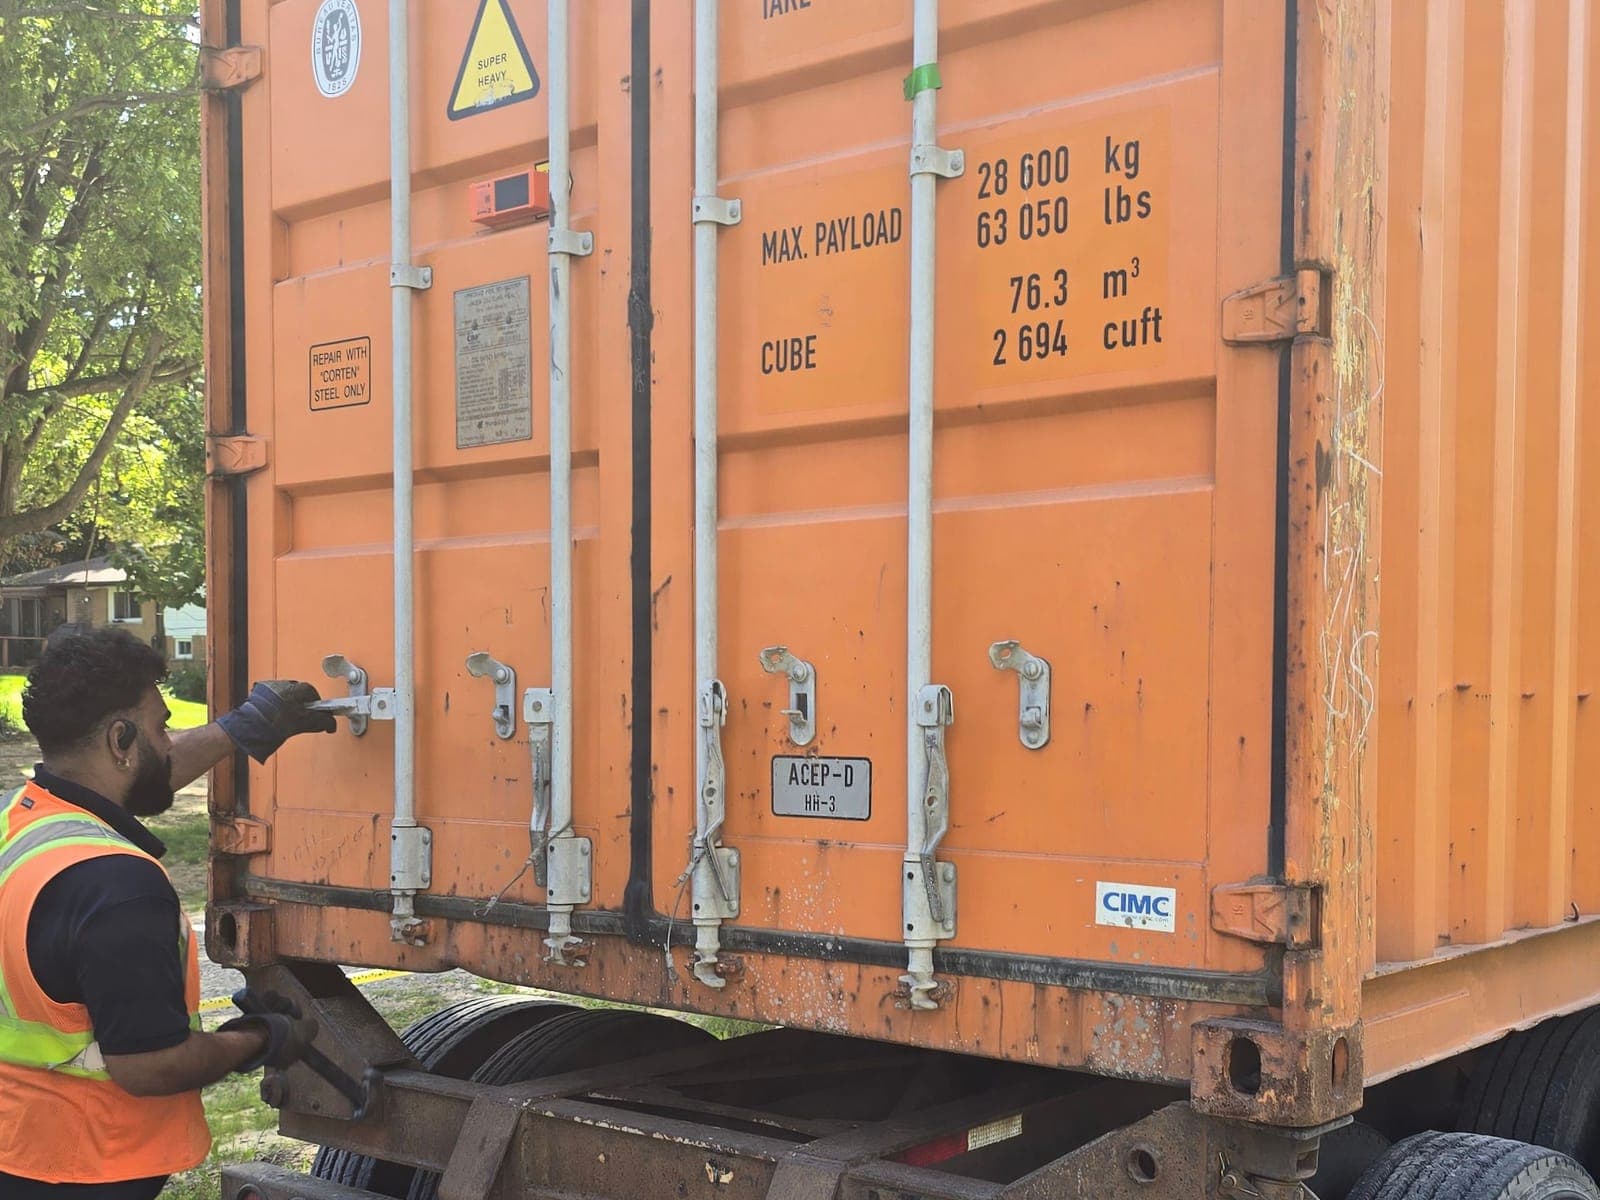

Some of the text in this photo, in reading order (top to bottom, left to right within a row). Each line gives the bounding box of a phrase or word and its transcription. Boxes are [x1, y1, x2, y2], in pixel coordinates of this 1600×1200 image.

[478, 53, 507, 70] SUPER
[478, 71, 507, 87] HEAVY
[978, 136, 1139, 199] 28 600 kg
[977, 185, 1151, 248] 63 050 lbs
[762, 208, 902, 266] MAX. PAYLOAD
[1010, 269, 1068, 313] 76.3
[993, 306, 1162, 365] 2 694 cuft
[313, 346, 367, 366] REPAIR WITH
[761, 335, 817, 374] CUBE
[314, 383, 366, 402] STEEL ONLY
[788, 763, 854, 787] ACEP-D
[804, 794, 836, 812] HH-3
[1103, 892, 1169, 917] CIMC
